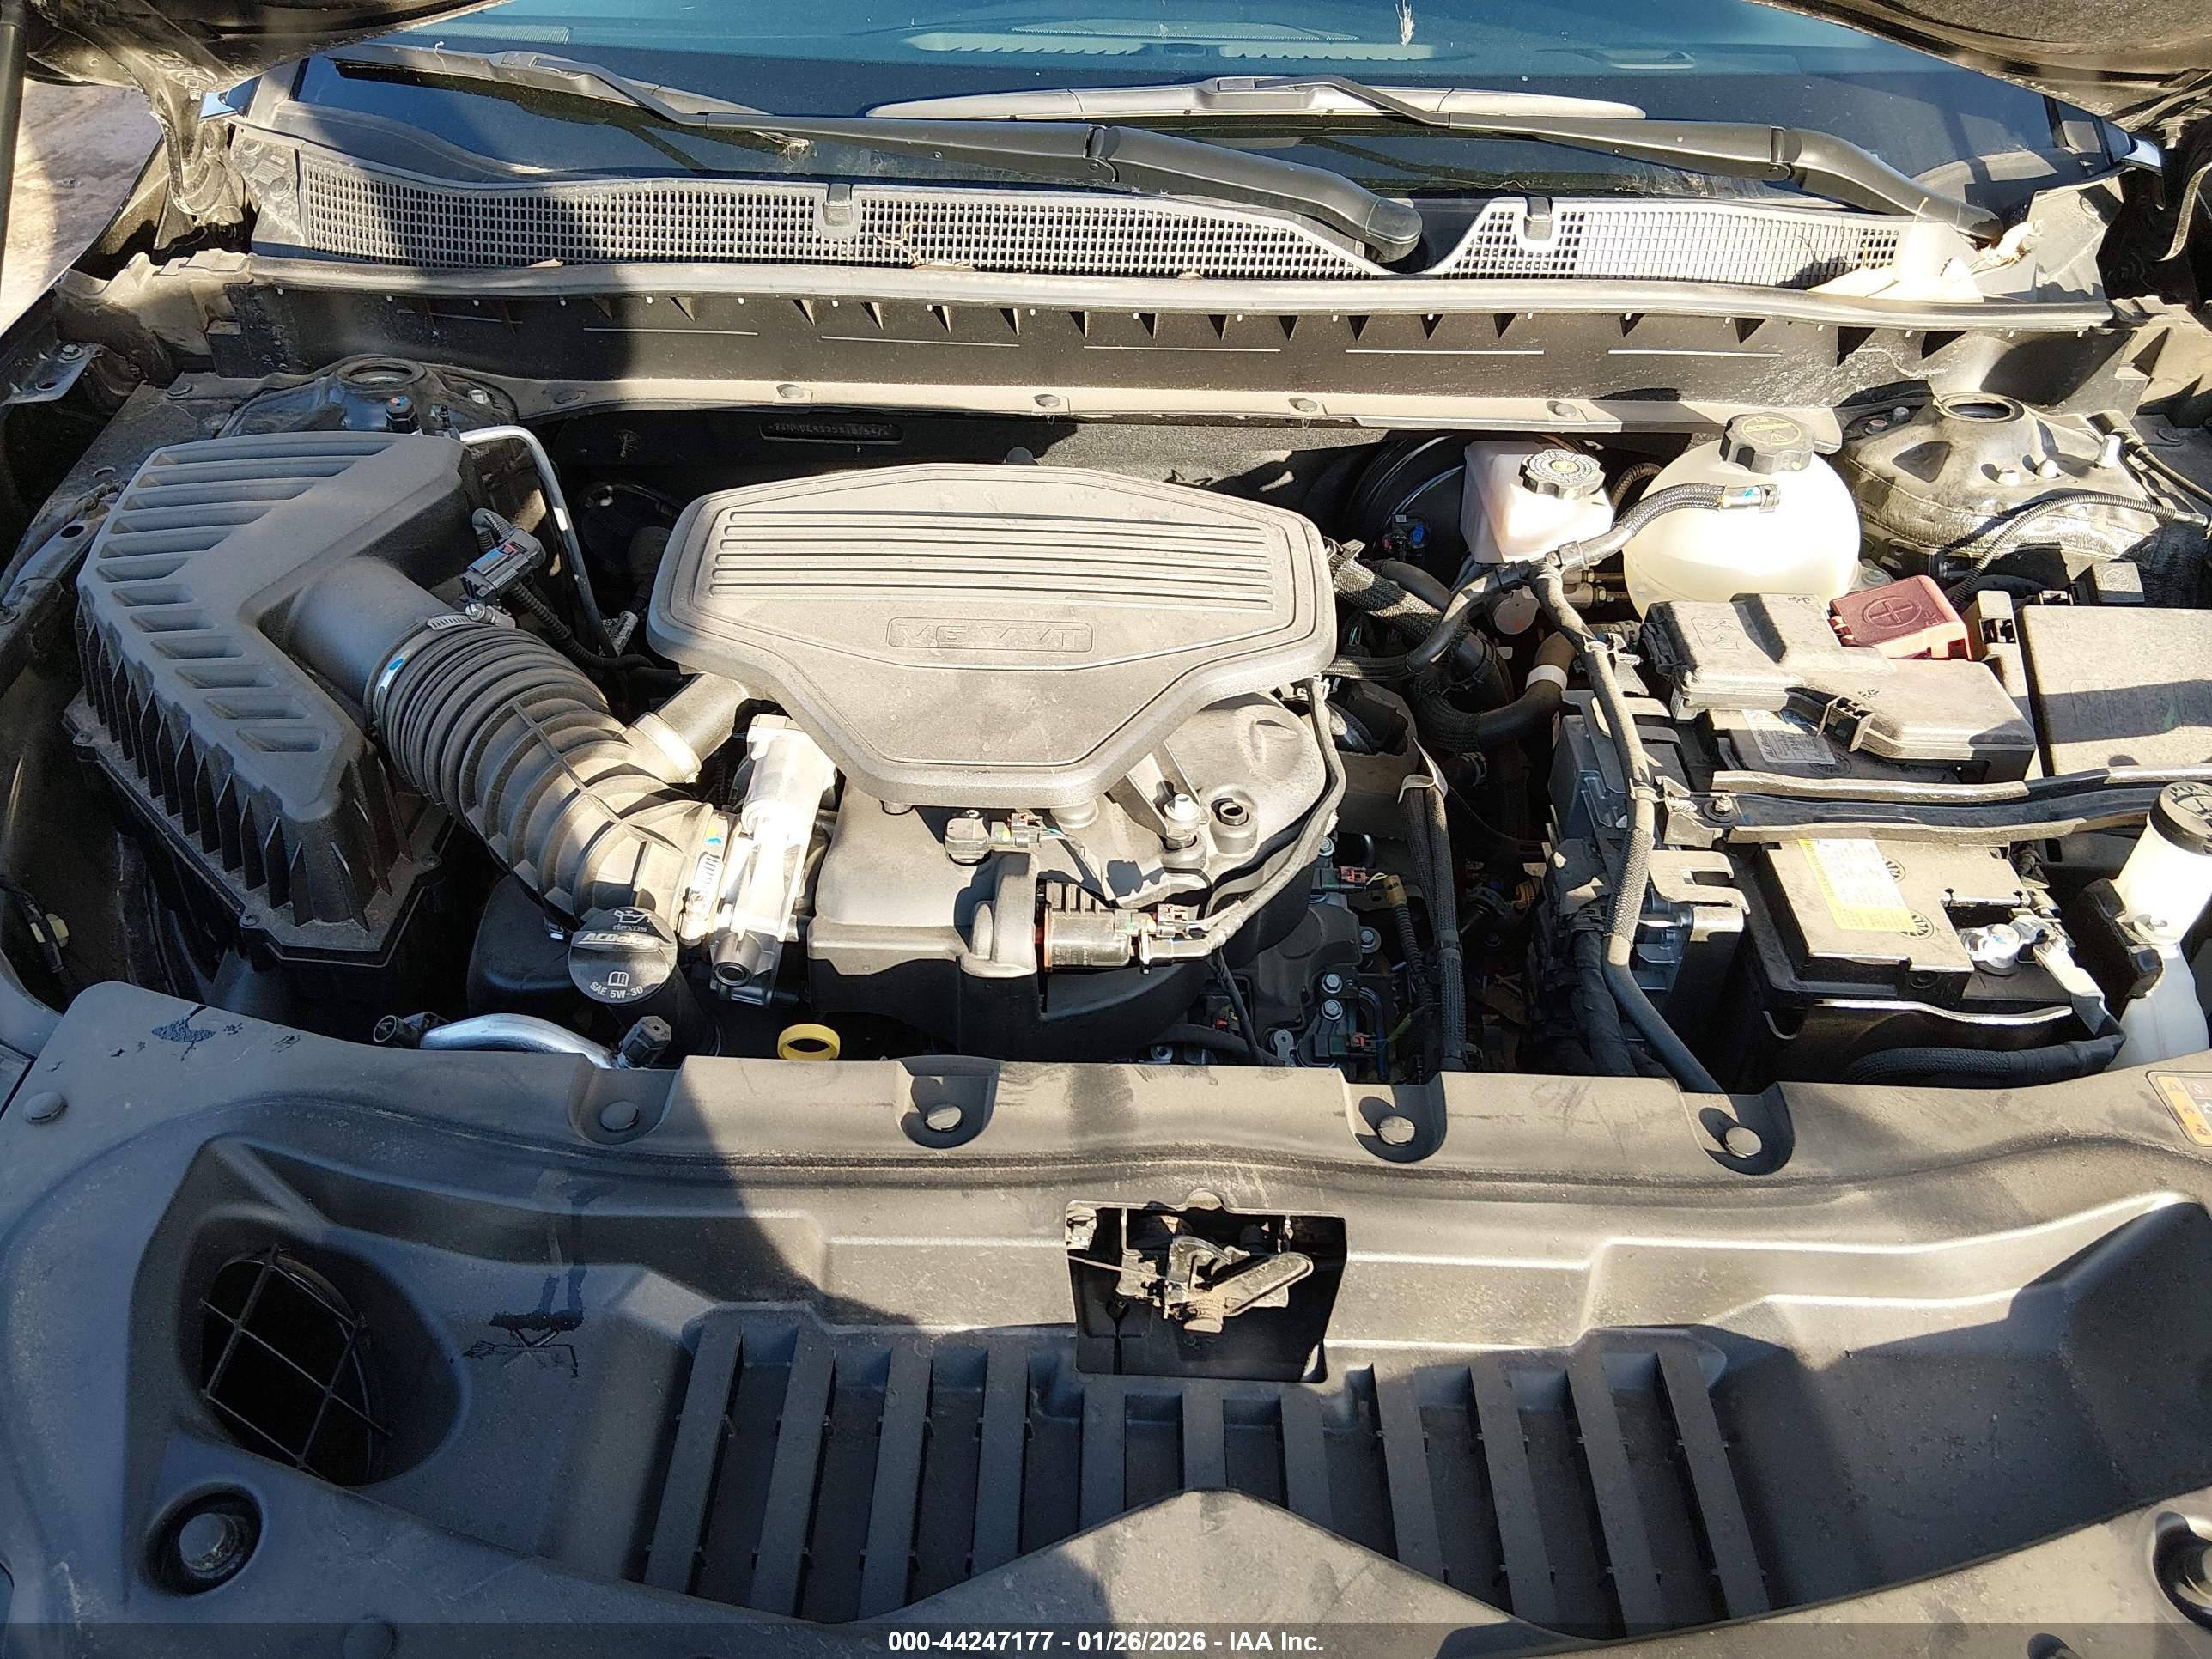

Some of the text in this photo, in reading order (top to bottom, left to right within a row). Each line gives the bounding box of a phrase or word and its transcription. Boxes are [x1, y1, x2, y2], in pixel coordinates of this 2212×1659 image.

[612, 923, 649, 933] dexos
[590, 981, 643, 998] SAE 5W-30
